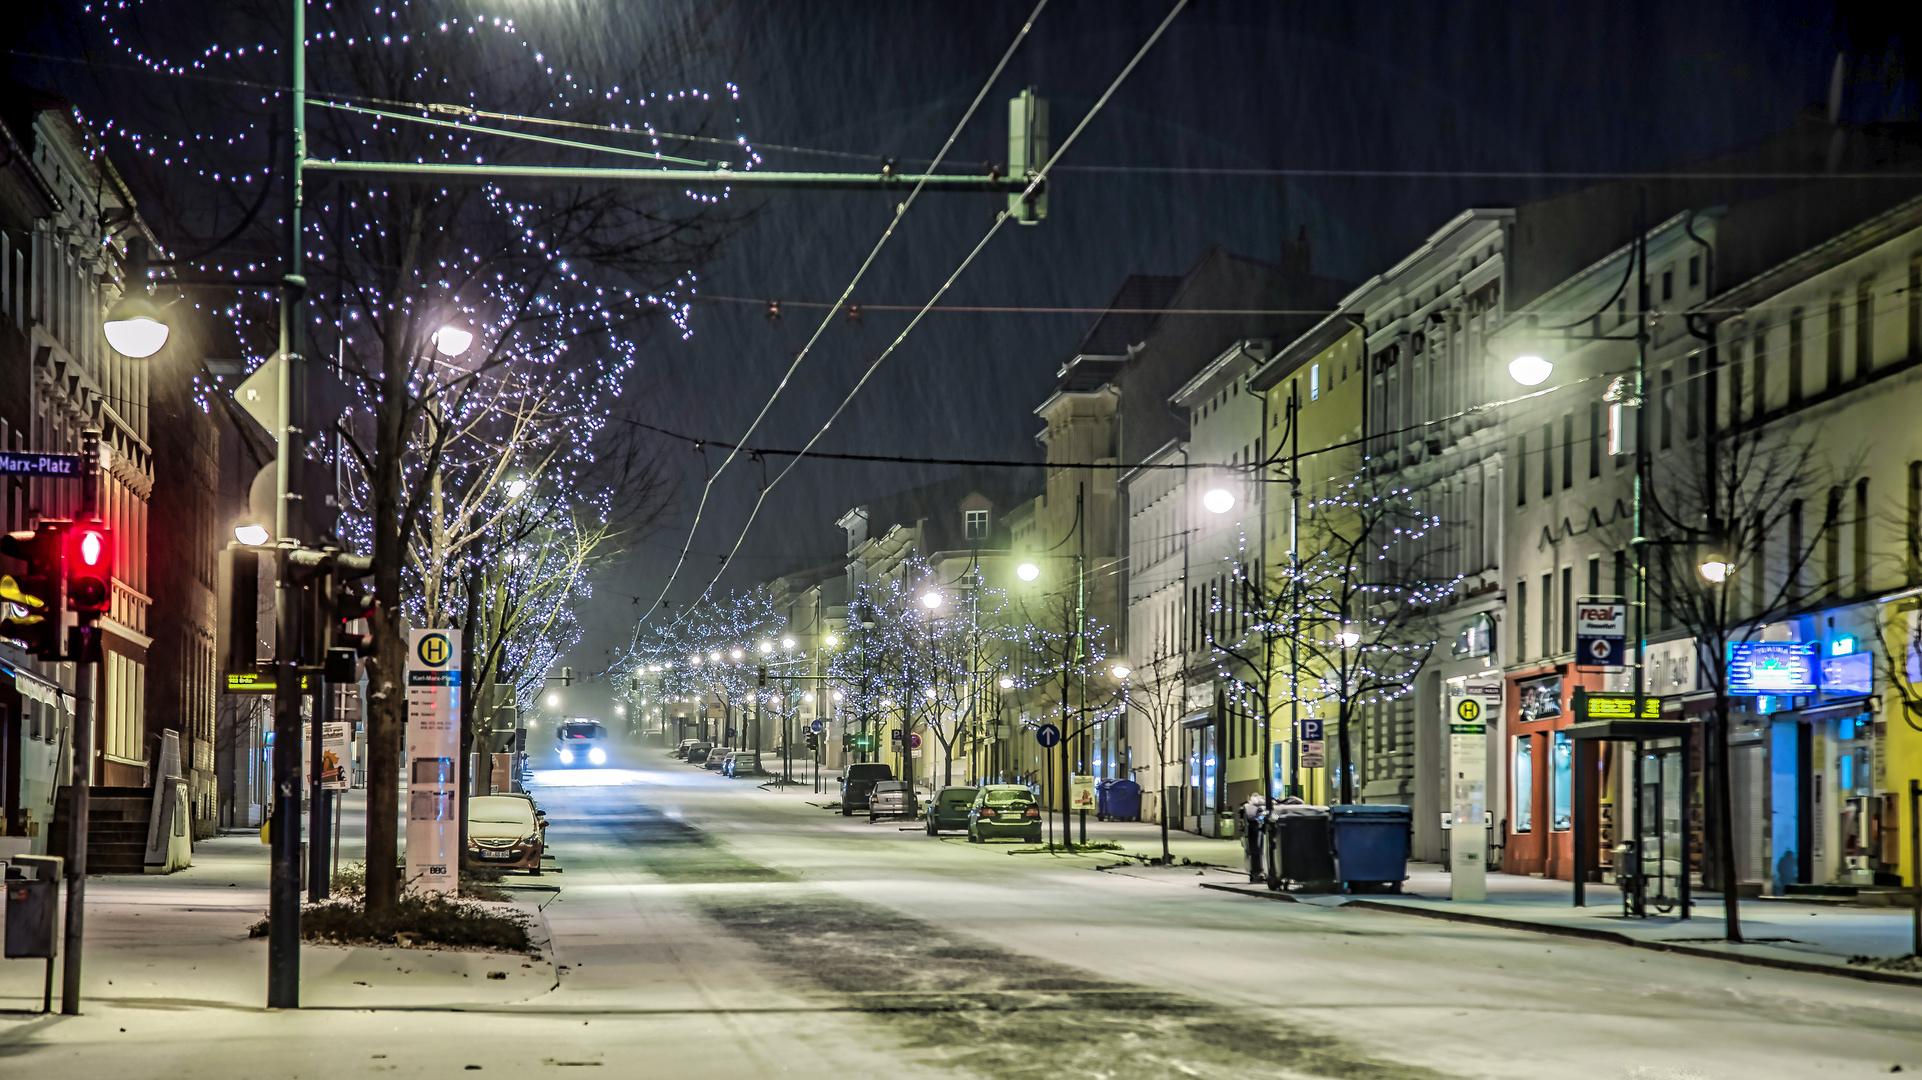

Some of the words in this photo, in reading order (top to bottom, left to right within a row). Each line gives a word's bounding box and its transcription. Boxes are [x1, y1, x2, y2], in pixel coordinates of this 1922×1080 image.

[0, 456, 71, 474] Marx-Platz
[427, 640, 443, 660] H
[1464, 704, 1474, 717] H
[1305, 721, 1319, 739] P
